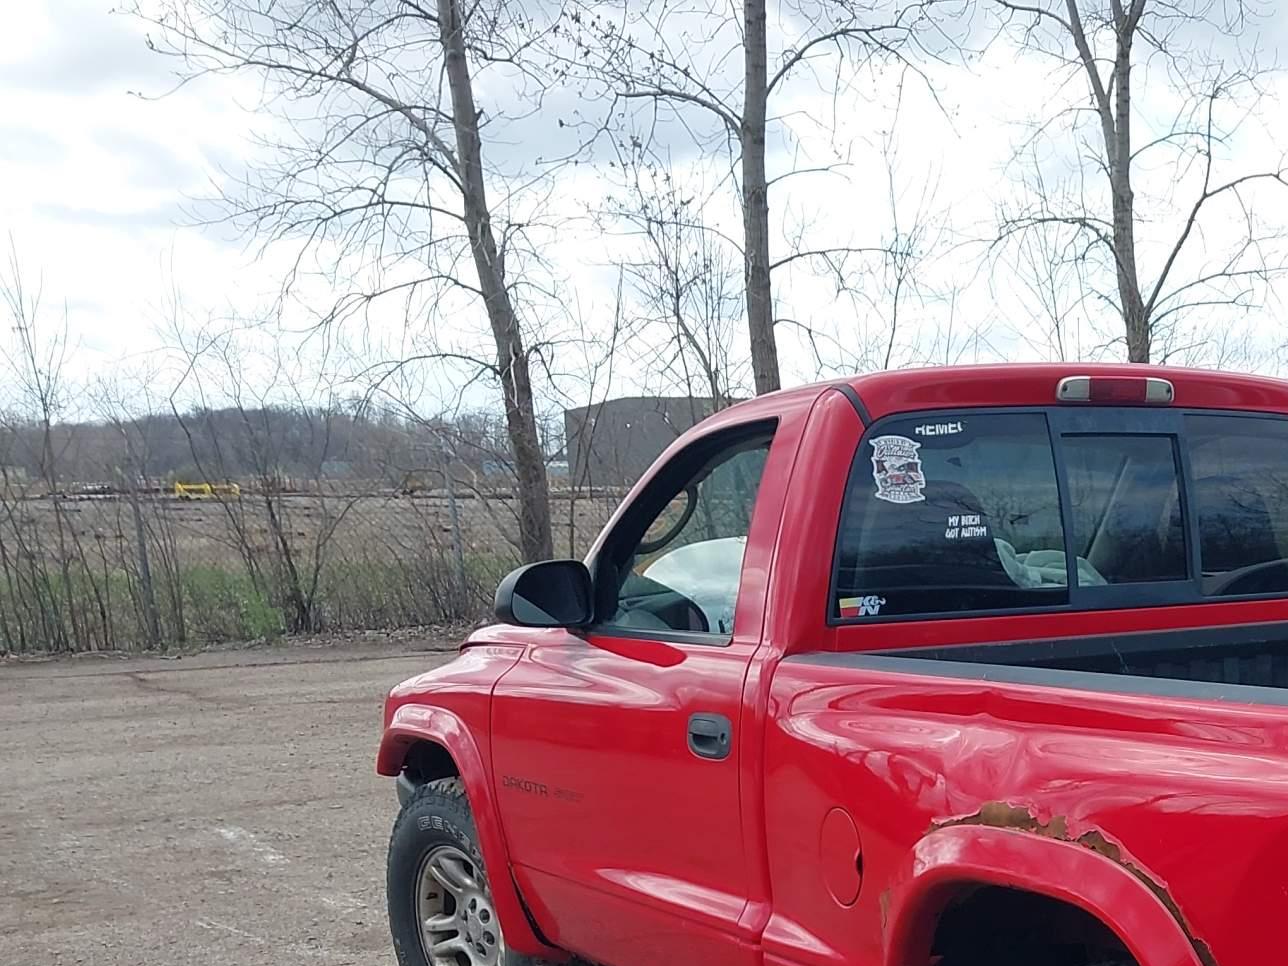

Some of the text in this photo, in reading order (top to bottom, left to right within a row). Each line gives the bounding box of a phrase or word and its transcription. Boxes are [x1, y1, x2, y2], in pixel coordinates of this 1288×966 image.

[948, 514, 981, 527] MY BITCH
[945, 526, 987, 539] GOT AUTISM
[502, 775, 549, 799] DAKOTA
